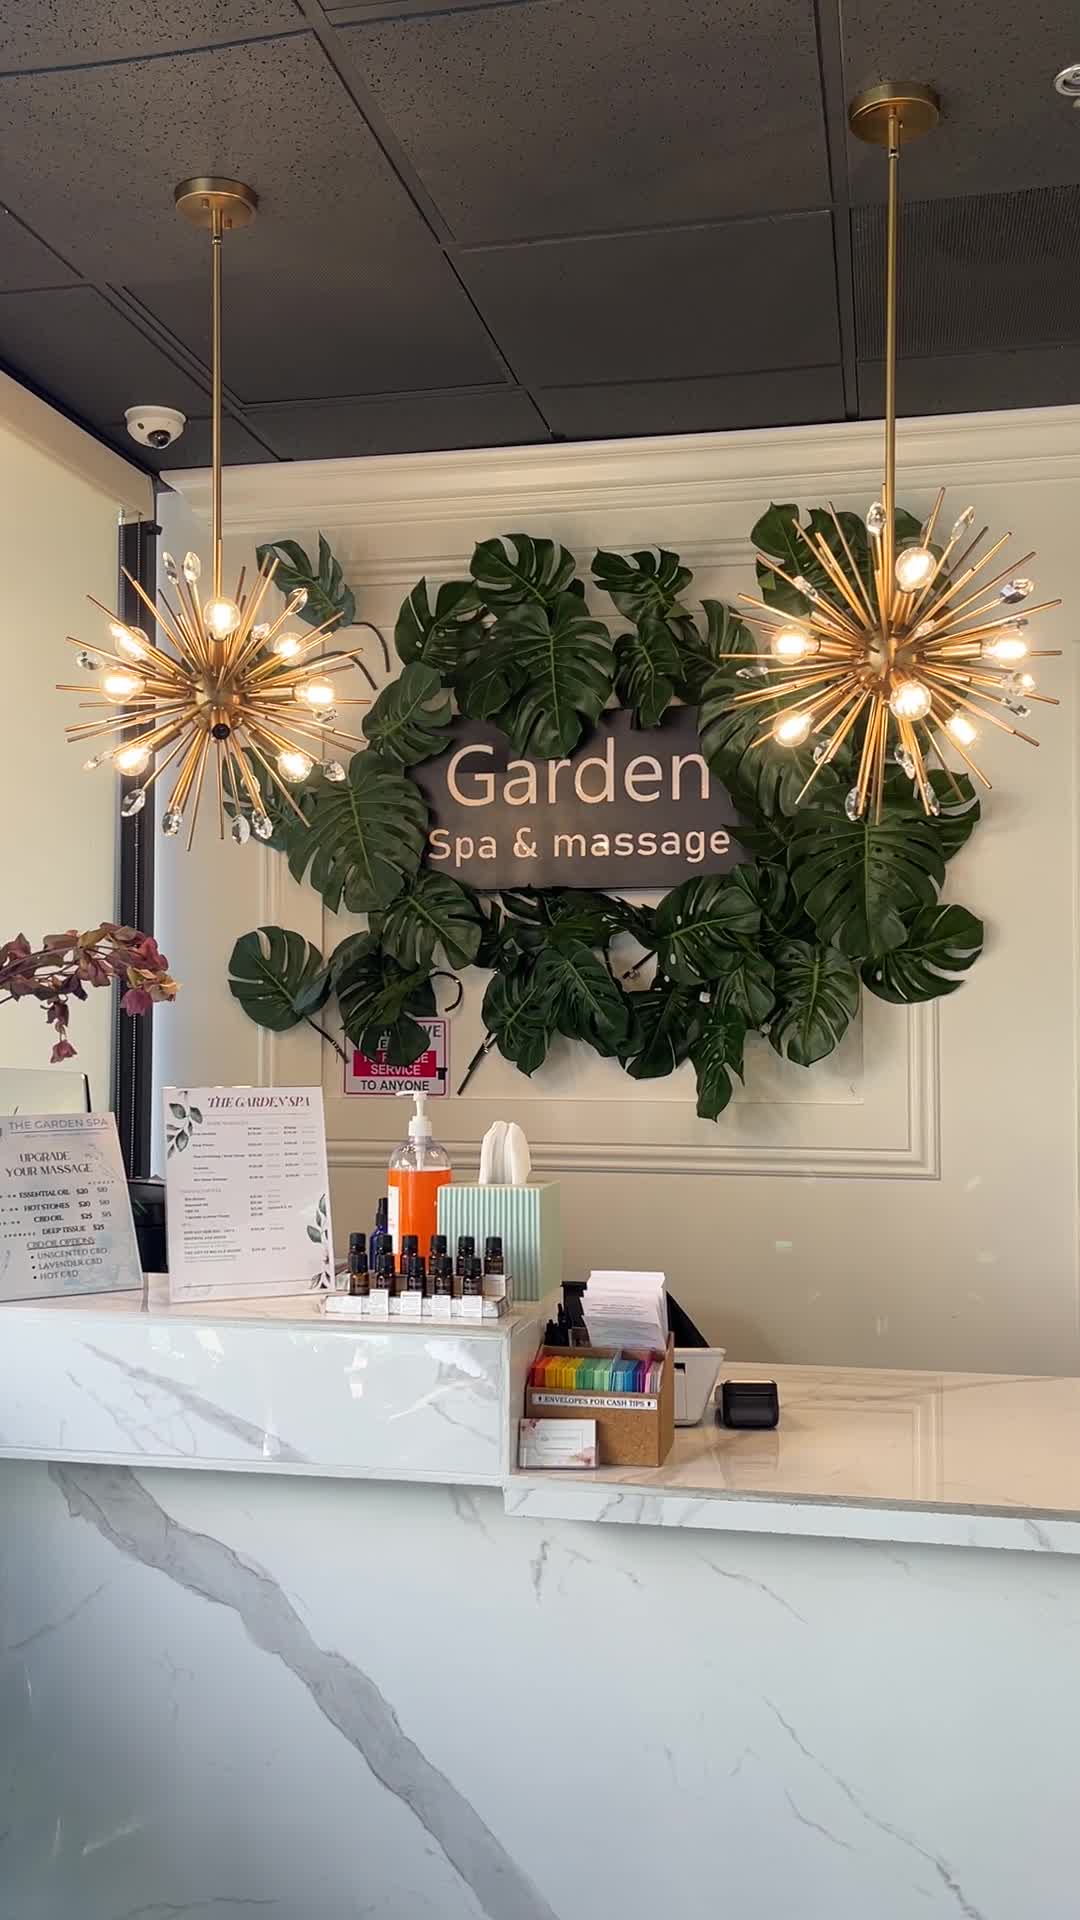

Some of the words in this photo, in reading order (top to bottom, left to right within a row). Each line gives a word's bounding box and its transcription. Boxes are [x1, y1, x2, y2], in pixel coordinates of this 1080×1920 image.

[446, 736, 710, 807] Garden
[428, 828, 497, 867] Spa
[512, 826, 538, 858] &
[553, 829, 731, 864] massage
[370, 1064, 422, 1076] SERVICE
[360, 1080, 377, 1091] TO
[380, 1080, 430, 1091] ANYONE
[208, 1096, 233, 1108] THE
[235, 1096, 287, 1108] GARDEN
[288, 1096, 310, 1107] SPA
[9, 1121, 32, 1131] THE
[35, 1119, 84, 1130] GARDEN
[86, 1117, 108, 1127] SPA
[19, 1151, 72, 1163] UPGRADE
[5, 1166, 38, 1177] YOUR
[40, 1163, 93, 1176] MASSAGE
[19, 1190, 57, 1199] ESSENTIAL
[57, 1189, 71, 1197] OIL
[41, 1202, 70, 1210] STONES
[544, 1395, 589, 1406] ENVELOPES
[590, 1398, 604, 1406] FOR
[606, 1399, 627, 1408] CASH
